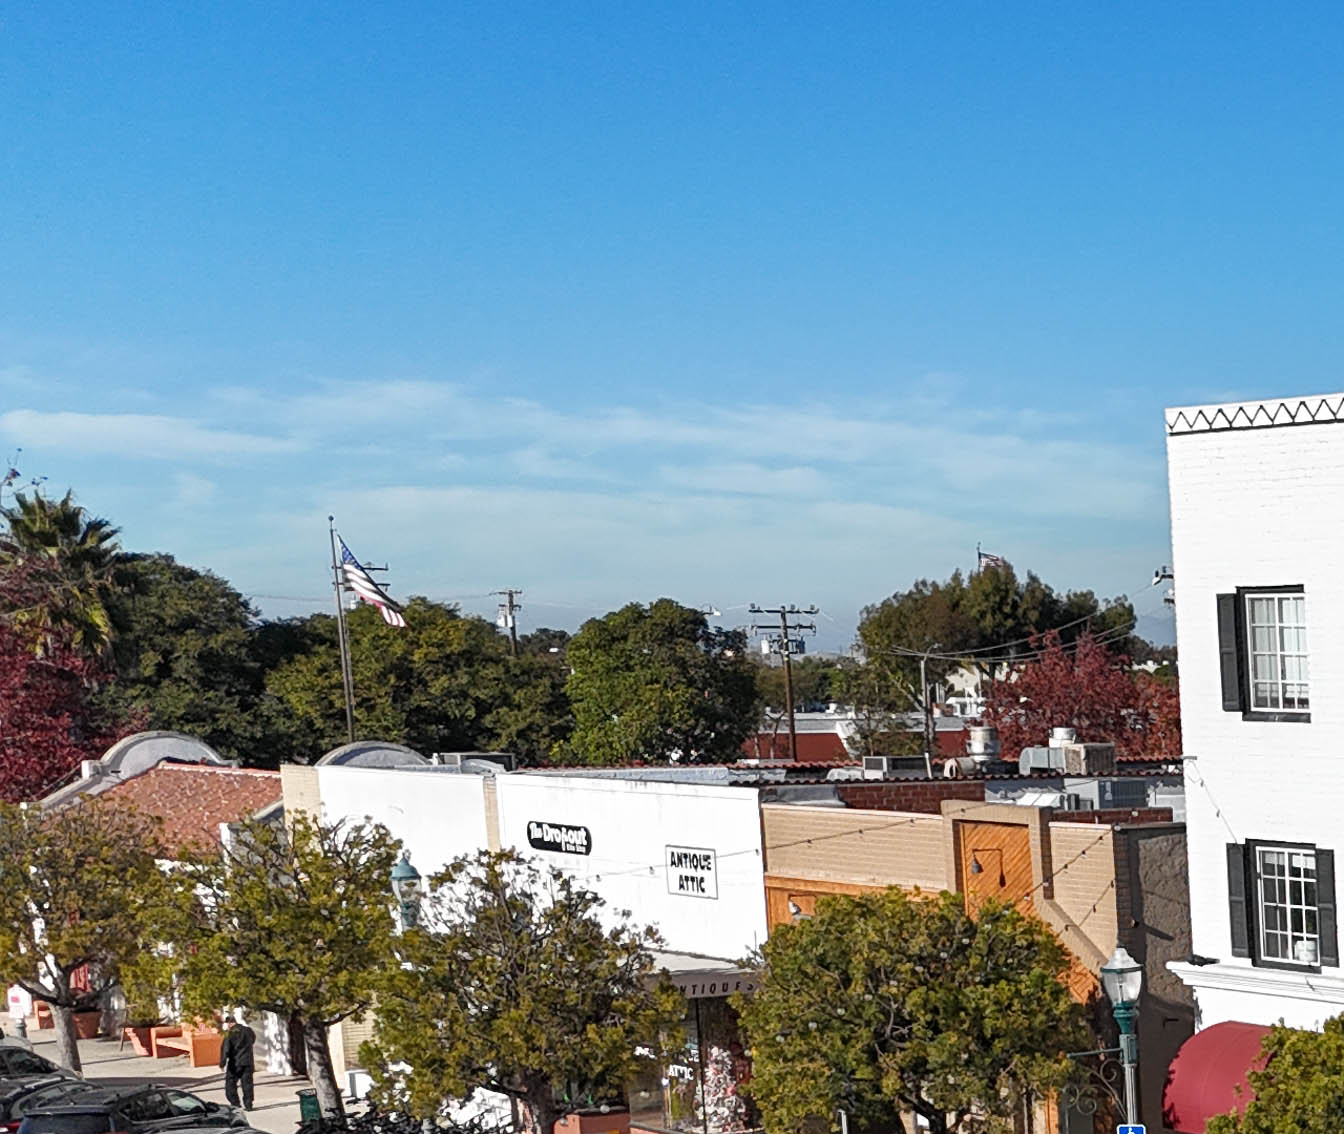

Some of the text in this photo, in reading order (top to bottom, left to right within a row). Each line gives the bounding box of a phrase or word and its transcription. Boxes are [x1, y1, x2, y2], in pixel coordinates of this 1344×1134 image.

[670, 851, 712, 871] ANTIQUE
[678, 874, 706, 893] ATTIC
[679, 981, 754, 995] NTIQUES
